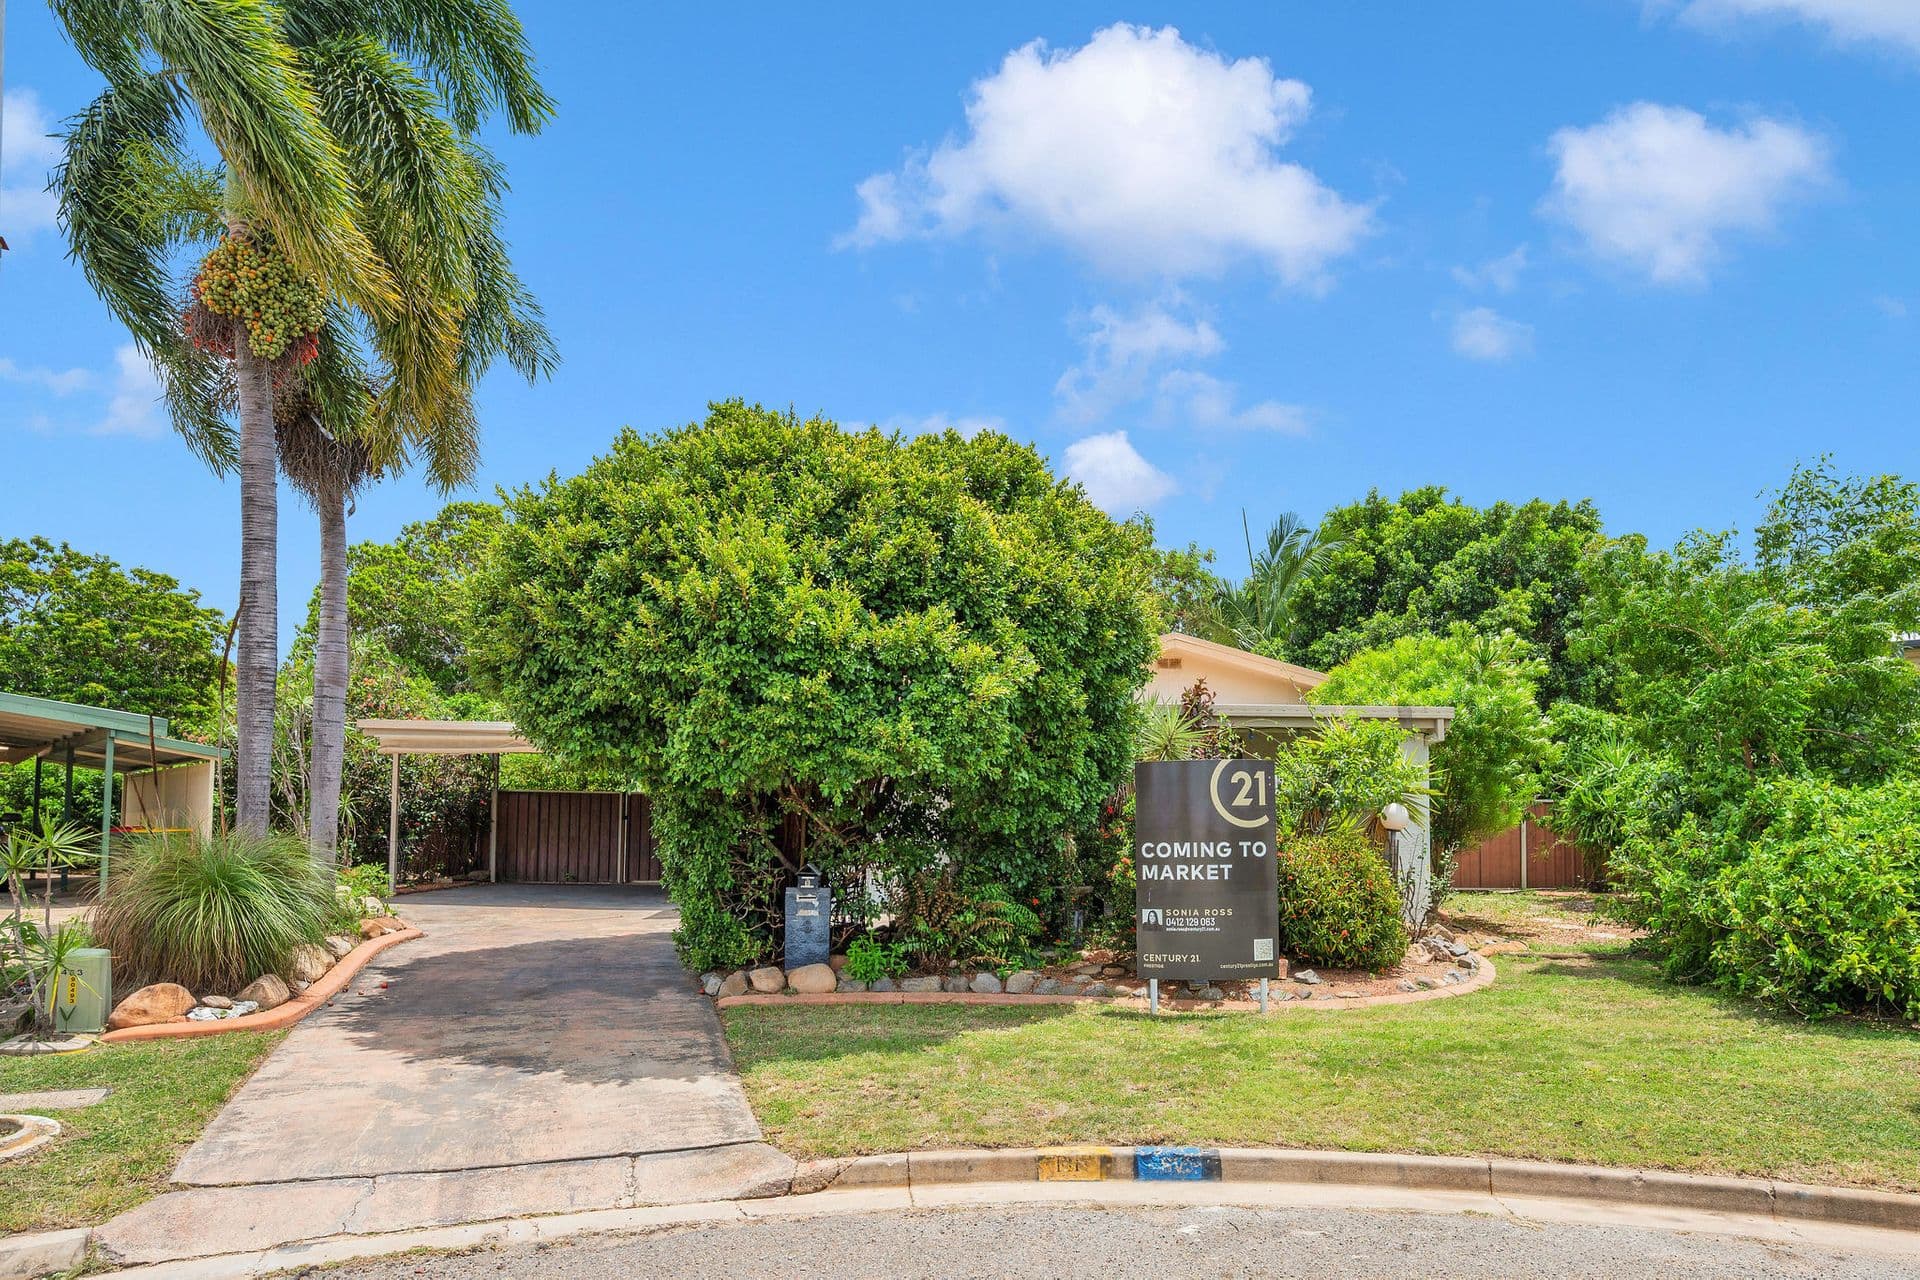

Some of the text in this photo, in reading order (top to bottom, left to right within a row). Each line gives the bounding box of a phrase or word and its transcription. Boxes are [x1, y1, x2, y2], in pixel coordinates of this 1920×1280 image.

[1141, 841, 1268, 859] COMING TO
[1142, 864, 1233, 881] MARKET
[1165, 908, 1234, 917] SONIA ROSS
[1165, 917, 1216, 927] 0412 129 063
[1143, 953, 1188, 963] CENTURY
